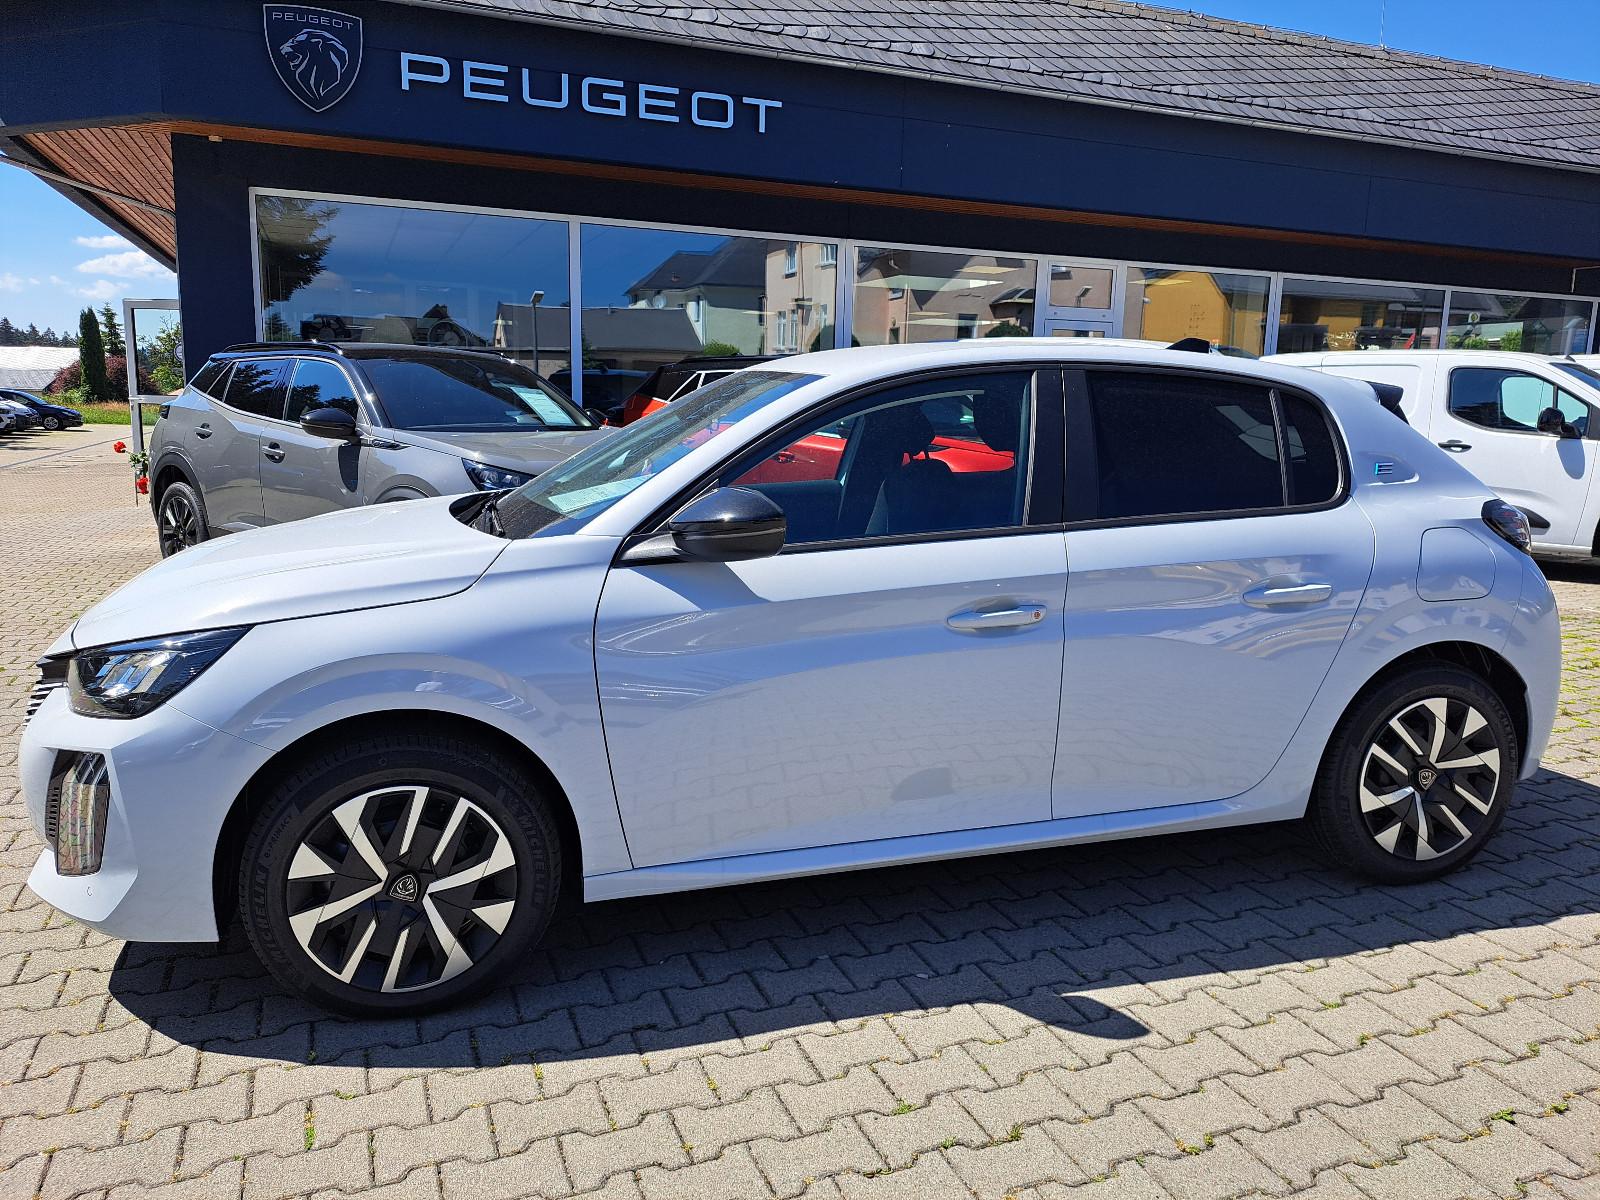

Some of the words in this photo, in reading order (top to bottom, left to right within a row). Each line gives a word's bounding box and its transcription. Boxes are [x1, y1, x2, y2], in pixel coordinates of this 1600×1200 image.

[272, 12, 354, 30] PEUGEOT
[400, 51, 783, 134] PEUGEOT
[518, 814, 545, 906] MICHELIN
[254, 869, 287, 961] MICHELIN
